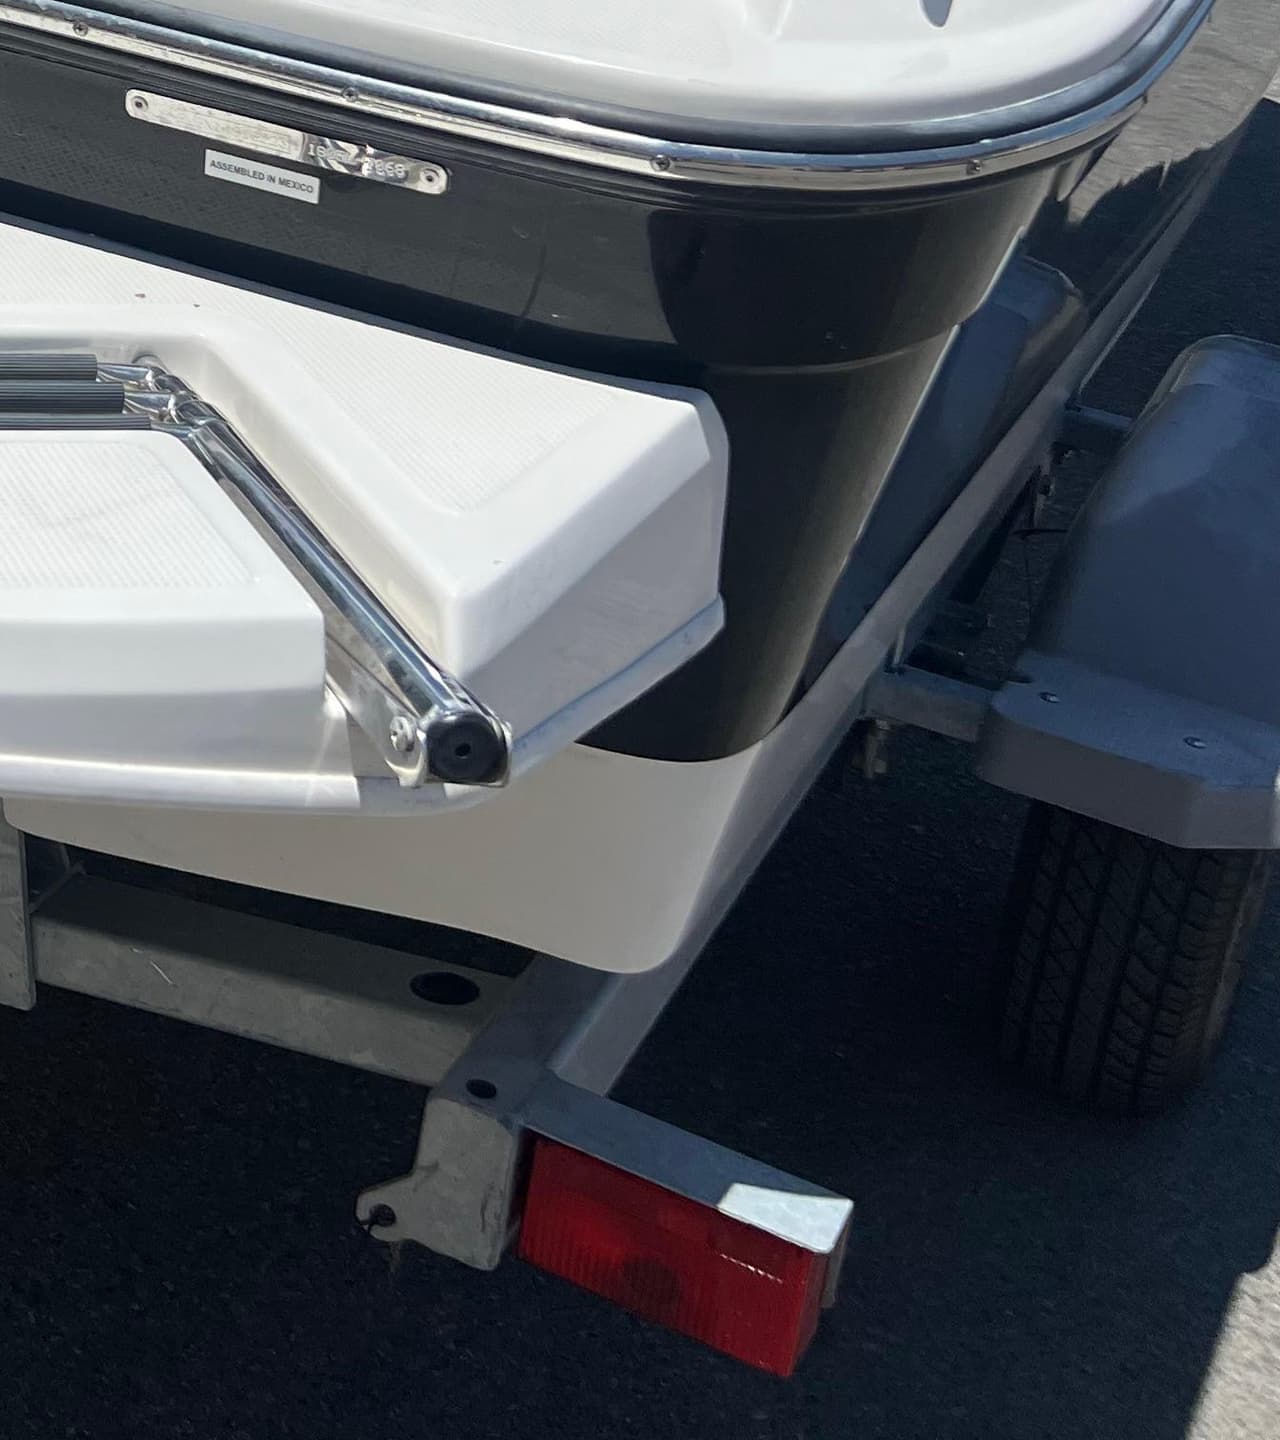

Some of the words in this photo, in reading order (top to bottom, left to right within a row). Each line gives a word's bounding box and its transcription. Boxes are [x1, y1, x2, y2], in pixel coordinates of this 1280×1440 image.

[210, 159, 266, 183] ASSEMBLED
[266, 172, 276, 184] IN
[278, 175, 314, 194] MEXICO
